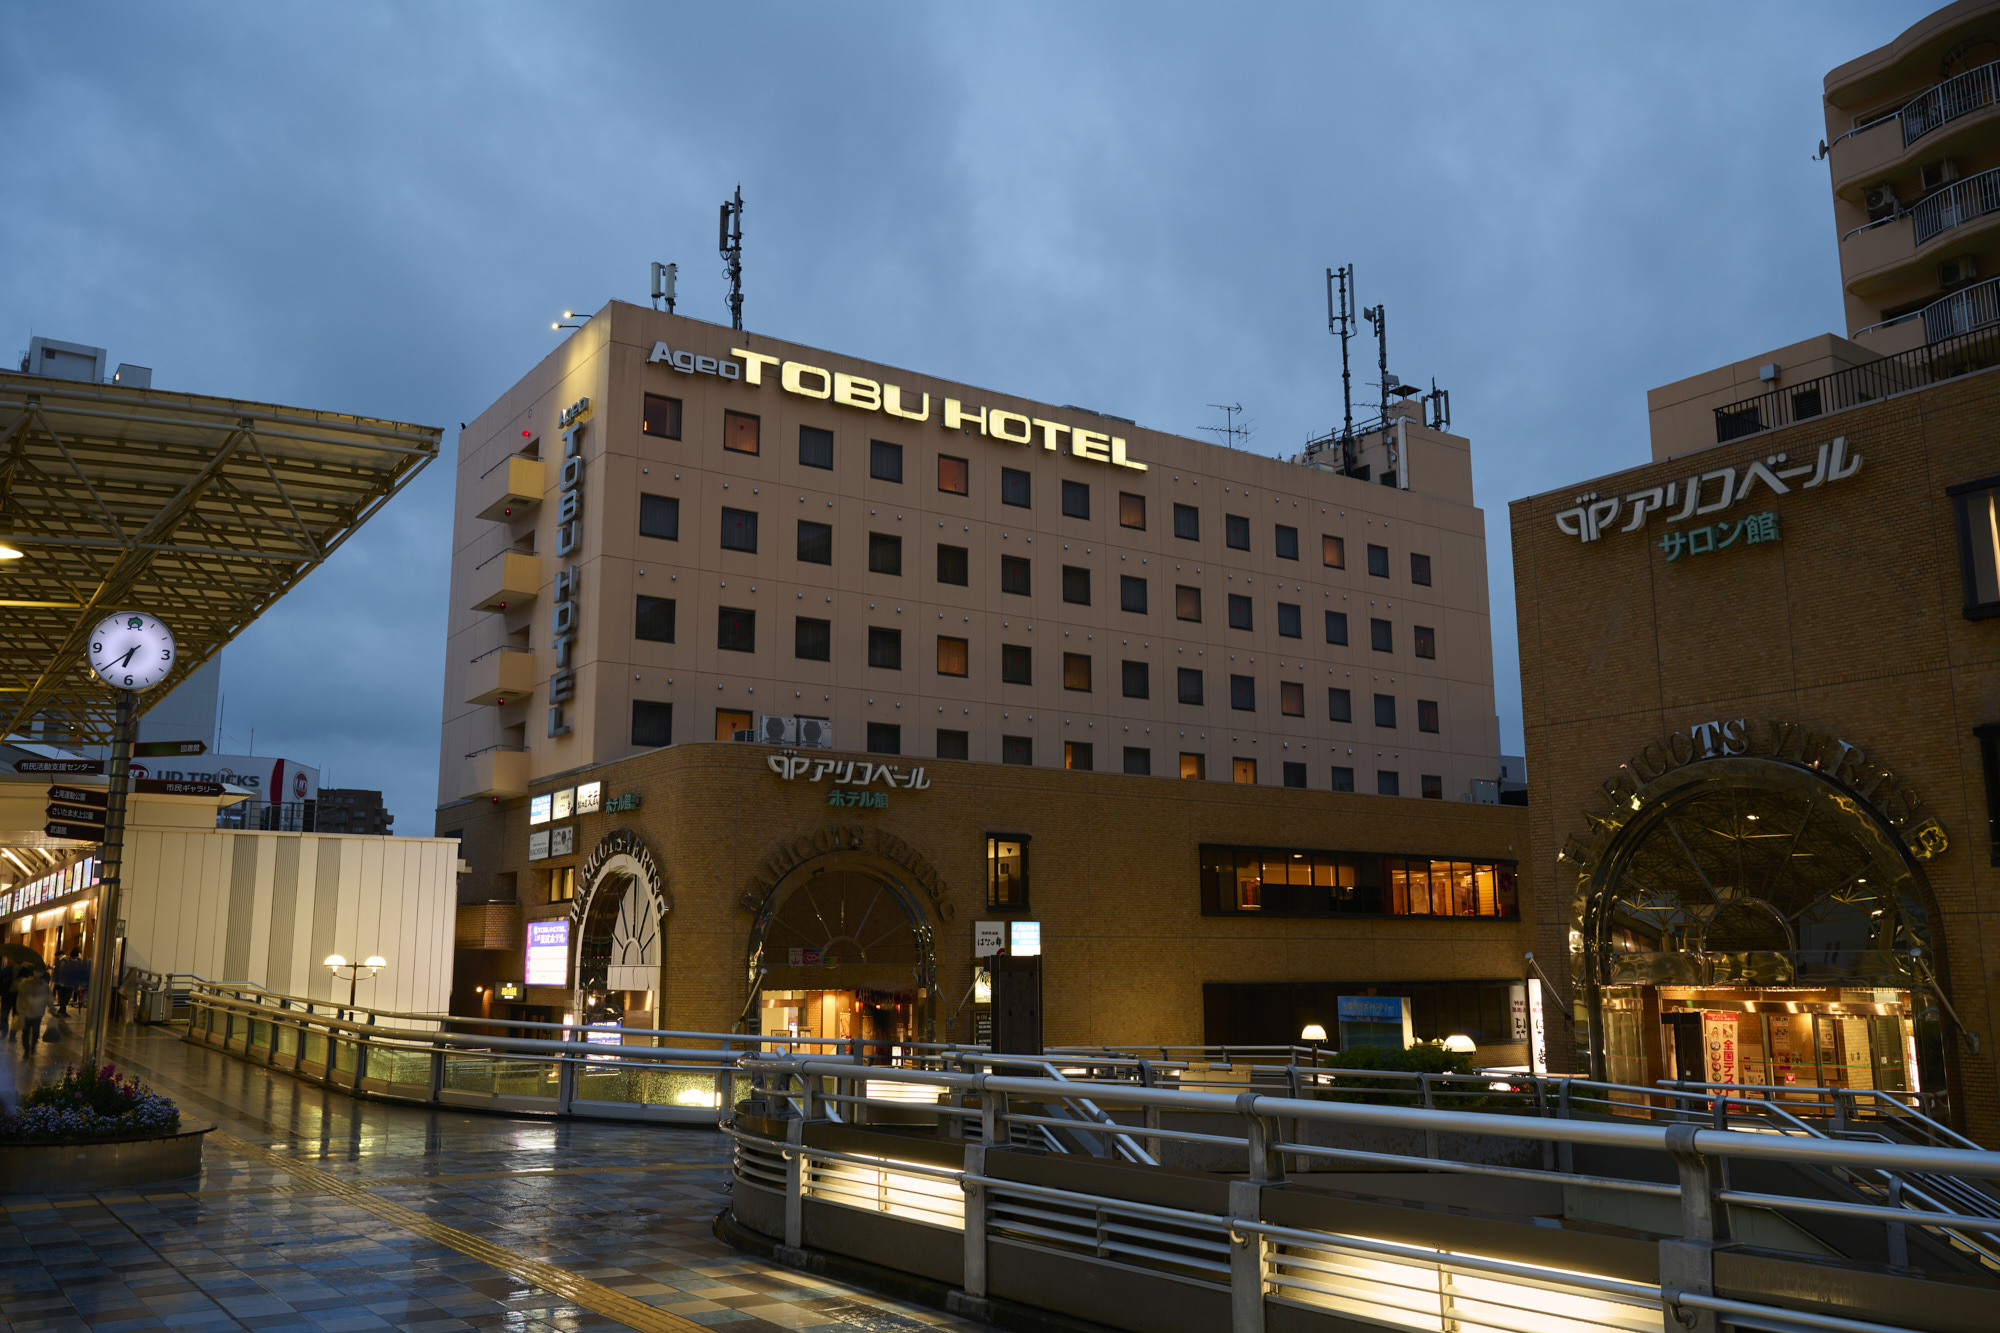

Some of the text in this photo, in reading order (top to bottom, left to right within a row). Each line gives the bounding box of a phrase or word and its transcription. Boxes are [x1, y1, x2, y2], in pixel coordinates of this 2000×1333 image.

[647, 341, 1149, 472] Ageo TOBU HOTEL
[1621, 436, 1863, 533] アリコベール
[1658, 511, 1781, 562] サロン館
[548, 397, 589, 739] Ageo TOBU HOTEL
[92, 642, 103, 654] 9
[160, 649, 171, 661] 3
[123, 674, 134, 686] 6
[20, 763, 96, 771] 市民活動支援センター
[809, 758, 931, 789] アリコベール
[187, 771, 260, 788] TRUCKS
[53, 789, 86, 801] 上尾運動公園
[166, 784, 218, 793] 市民ギャラリー
[605, 793, 634, 815] ホテル館
[828, 790, 888, 809] ホテル館
[51, 807, 94, 820] さいたま水上公園
